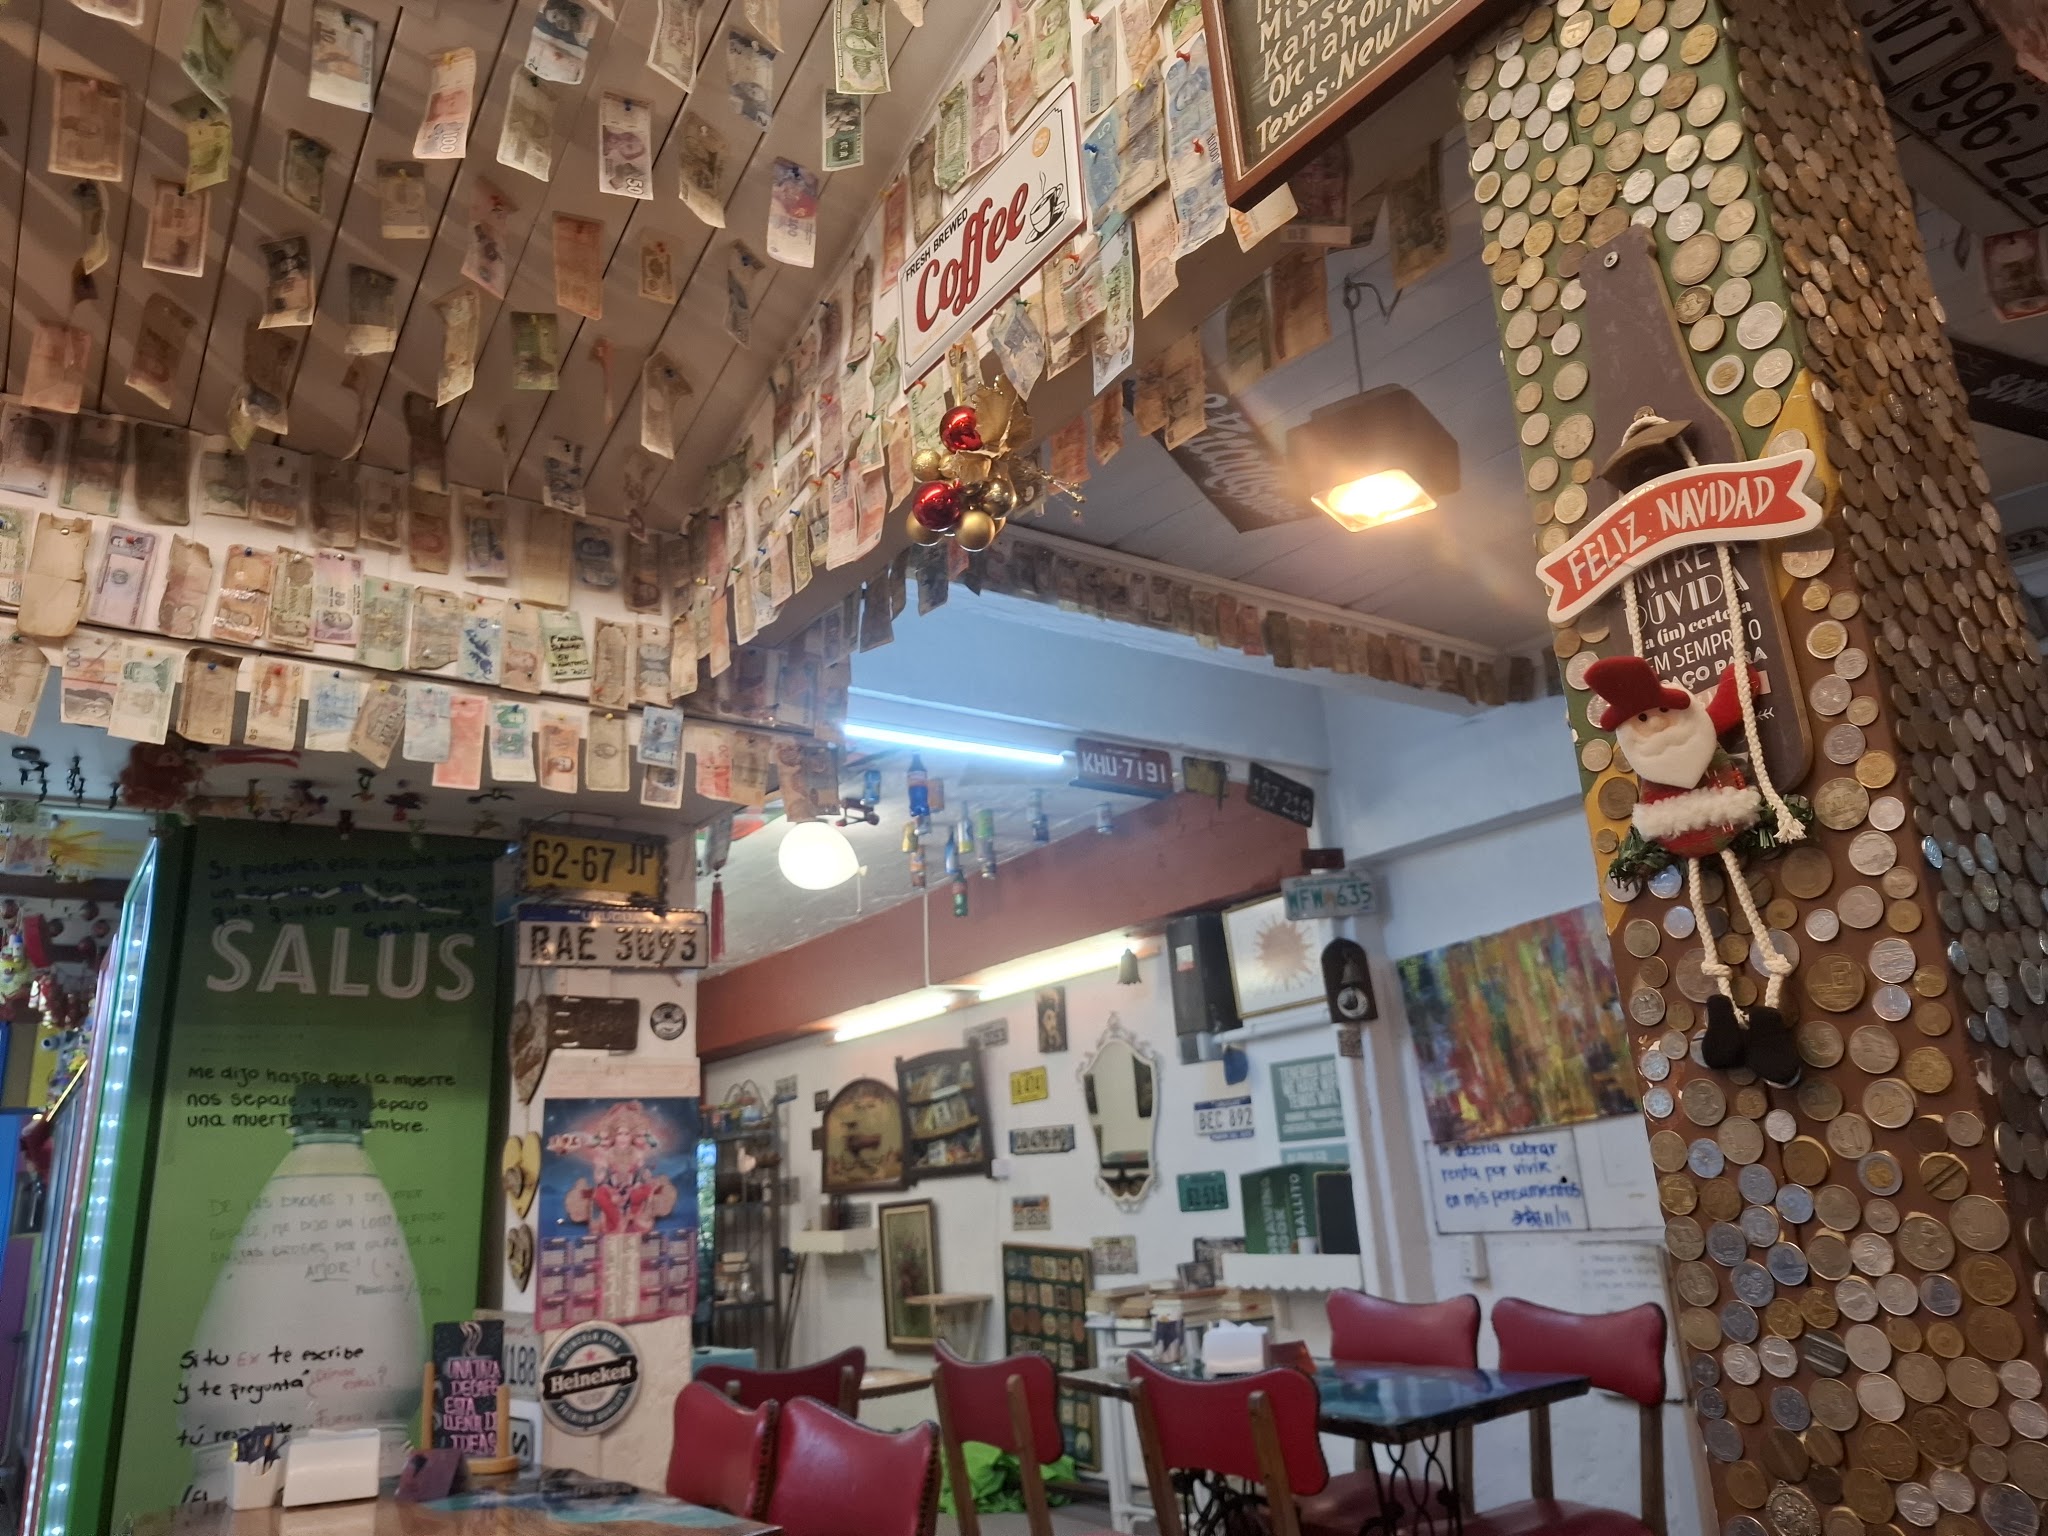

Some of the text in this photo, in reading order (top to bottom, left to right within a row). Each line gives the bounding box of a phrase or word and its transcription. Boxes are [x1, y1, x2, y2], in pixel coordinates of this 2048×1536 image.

[440, 130, 462, 153] 100
[626, 178, 644, 195] 50
[905, 208, 968, 282] FRESH BREWED
[916, 183, 1028, 332] Coffee
[1567, 476, 1775, 590] FELIZ NAVIDAD
[1657, 622, 1686, 647] (in)
[1688, 601, 1752, 633] certea
[1673, 628, 1735, 668] SEMPR
[532, 839, 654, 884] 62-67 JP
[206, 918, 476, 1002] SALUS
[530, 925, 698, 967] RAE 3093
[187, 1092, 221, 1108] nos
[187, 1113, 224, 1129] una
[268, 1345, 292, 1364] te
[198, 1380, 222, 1397] te
[550, 1359, 632, 1394] Heineken
